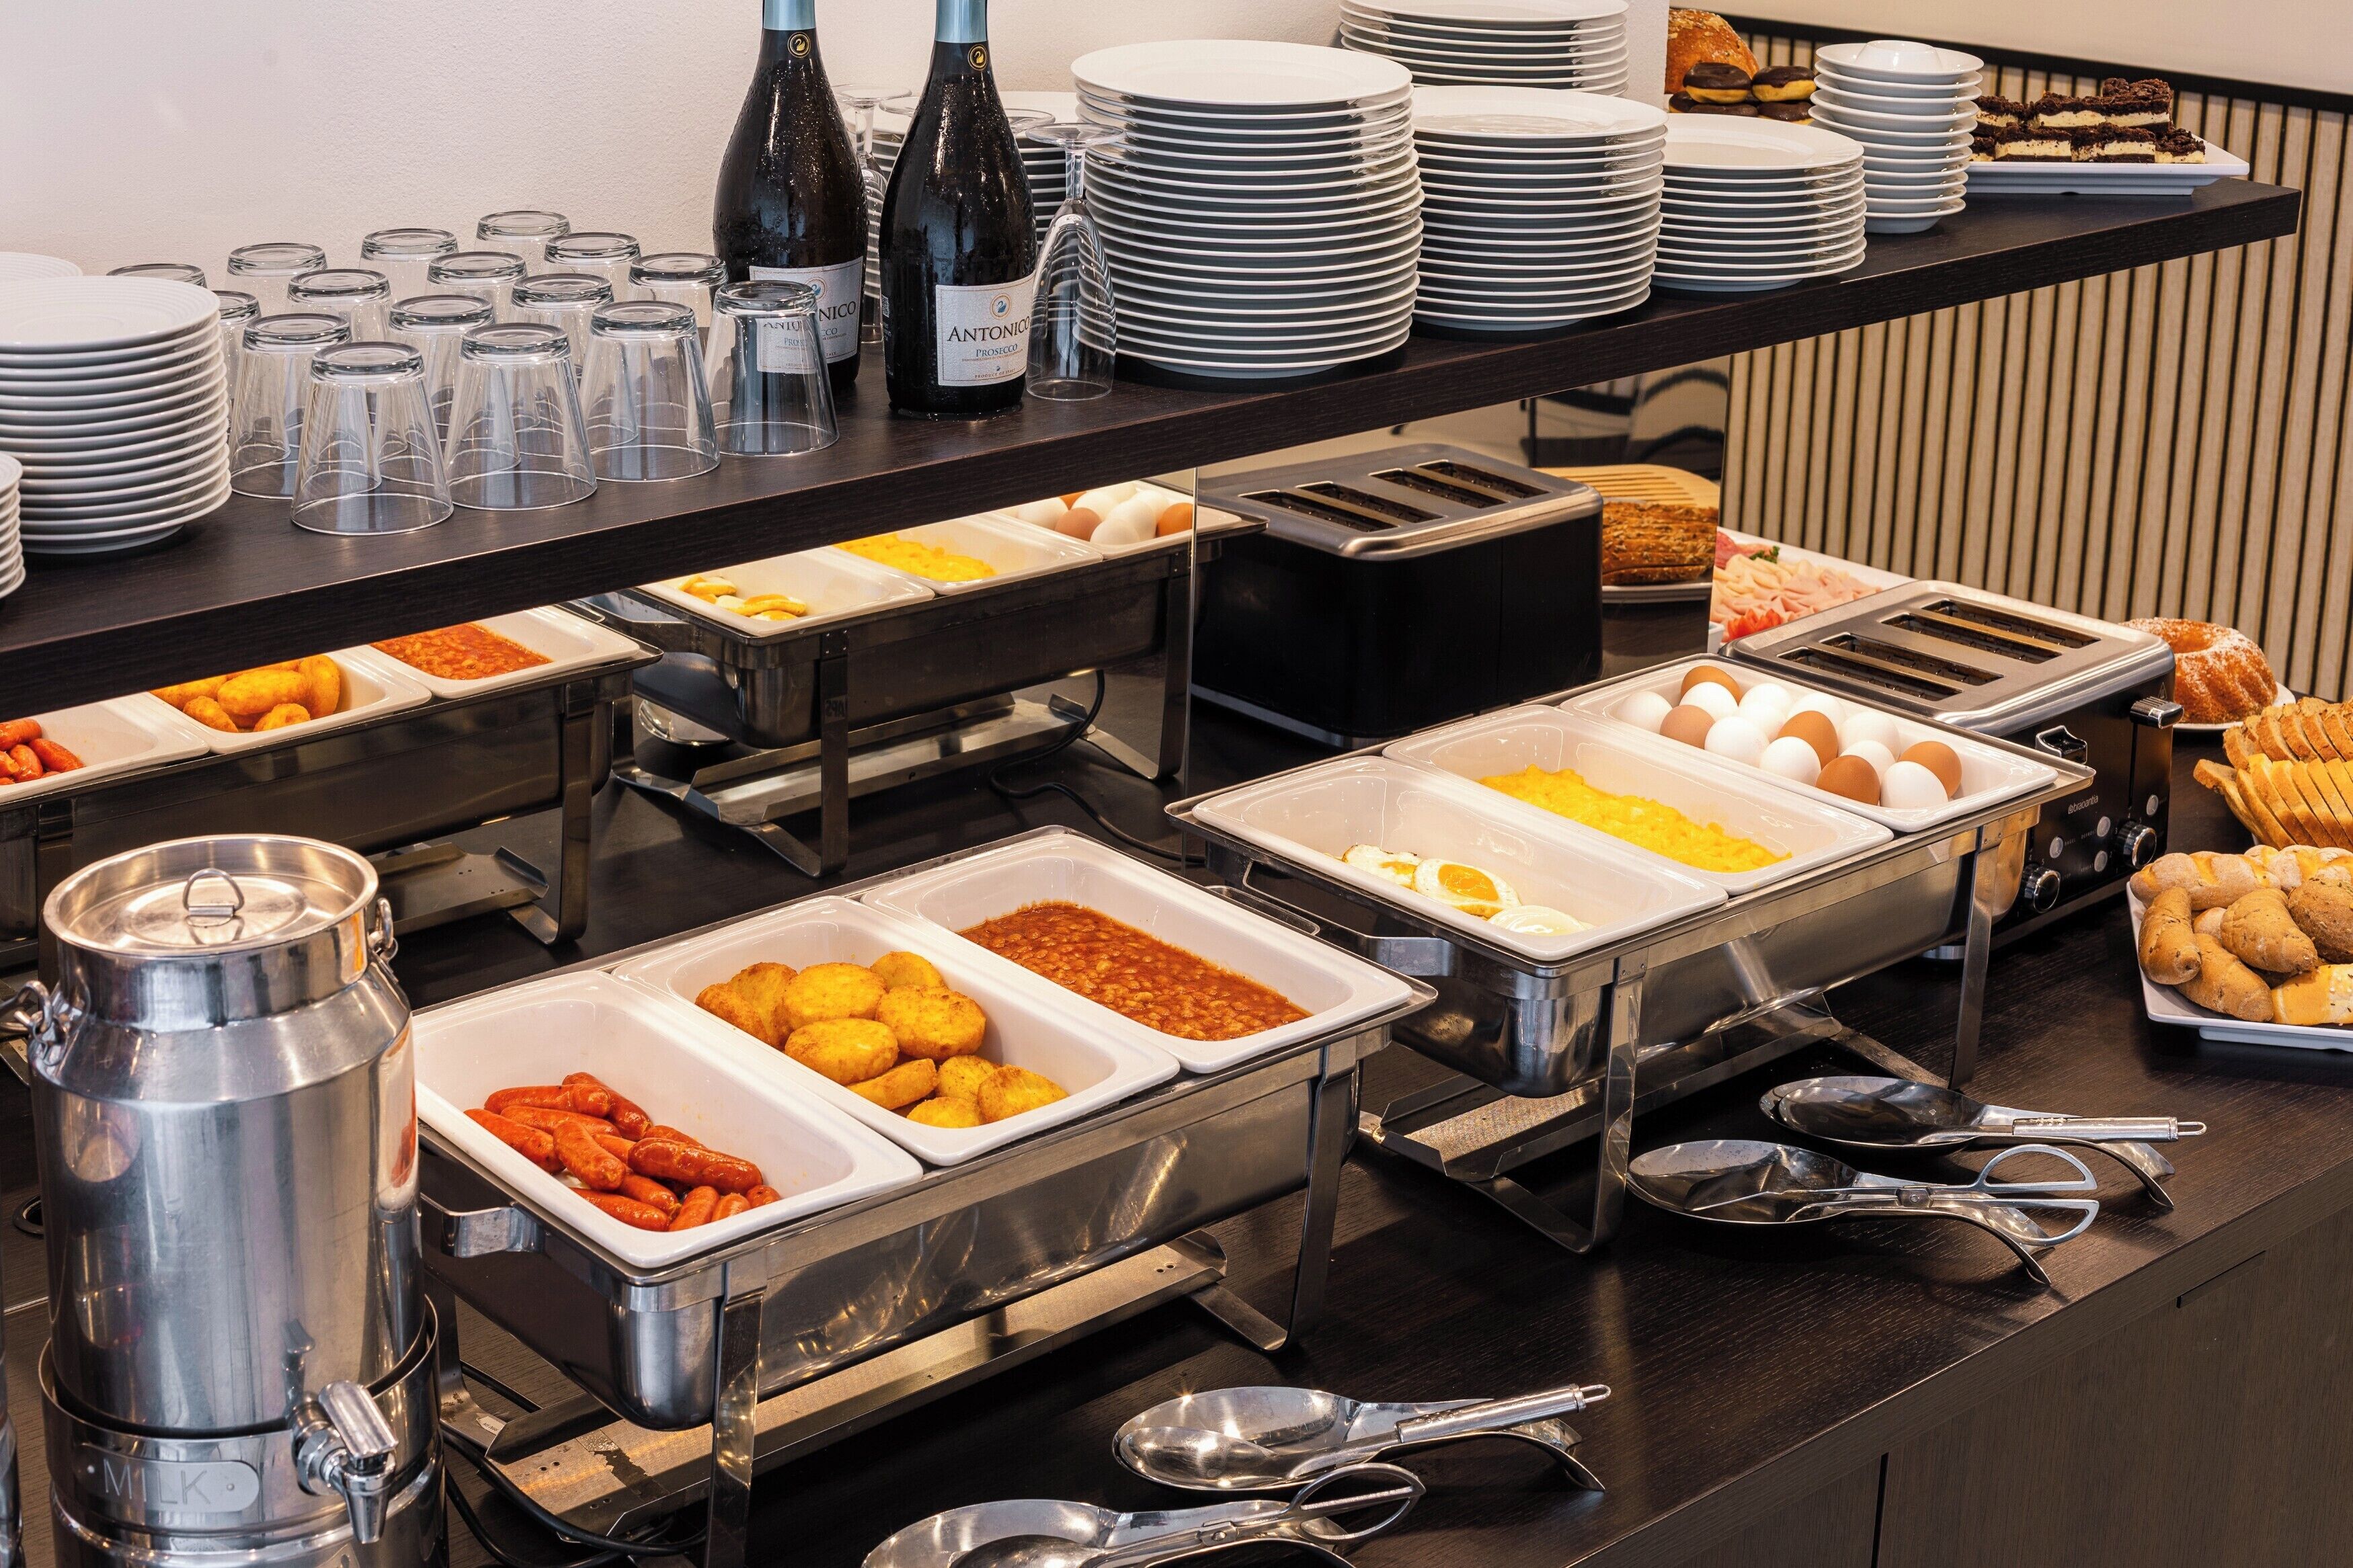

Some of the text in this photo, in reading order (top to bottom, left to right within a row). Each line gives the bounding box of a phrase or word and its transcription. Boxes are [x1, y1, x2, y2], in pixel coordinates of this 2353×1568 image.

[947, 316, 1031, 342] ANTONICO
[975, 343, 1019, 358] PROSECCO
[2073, 794, 2099, 812] brabantia
[103, 1458, 211, 1505] MILK
